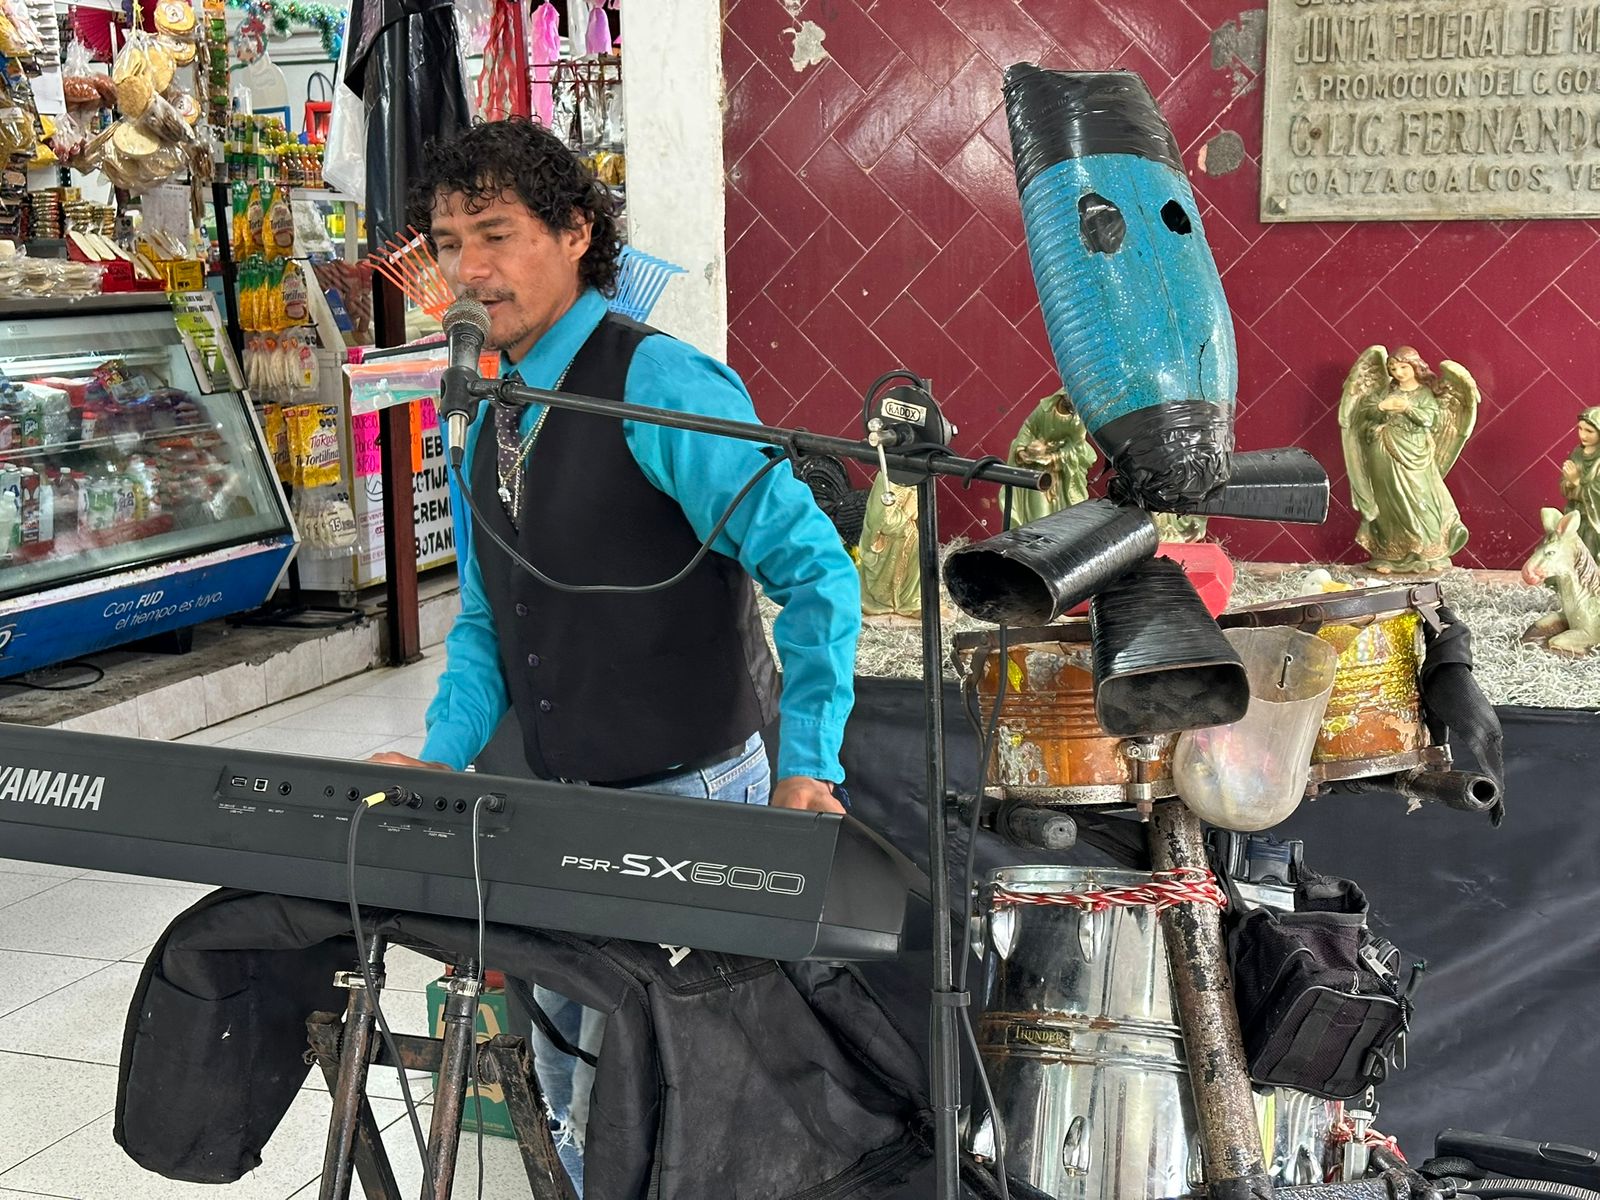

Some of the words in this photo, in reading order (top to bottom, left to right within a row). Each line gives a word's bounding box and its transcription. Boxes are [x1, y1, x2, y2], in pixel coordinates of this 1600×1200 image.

[1293, 14, 1381, 64] JUNTA
[1393, 8, 1518, 62] FEDERAL
[1525, 7, 1564, 57] DE
[1319, 71, 1472, 99] PROMOCION
[1479, 68, 1525, 97] DEL
[1401, 105, 1600, 156] FERNAND
[1287, 164, 1553, 195] COATZACOALCOS,
[888, 404, 917, 420] RADOX
[305, 447, 340, 466] Tortillina
[103, 601, 134, 618] Con
[136, 590, 164, 609] FUD
[115, 615, 130, 630] el
[130, 604, 177, 627] tiempo
[179, 599, 194, 613] es
[0, 766, 105, 811] YAMAHA
[561, 853, 805, 896] PSR-SX600
